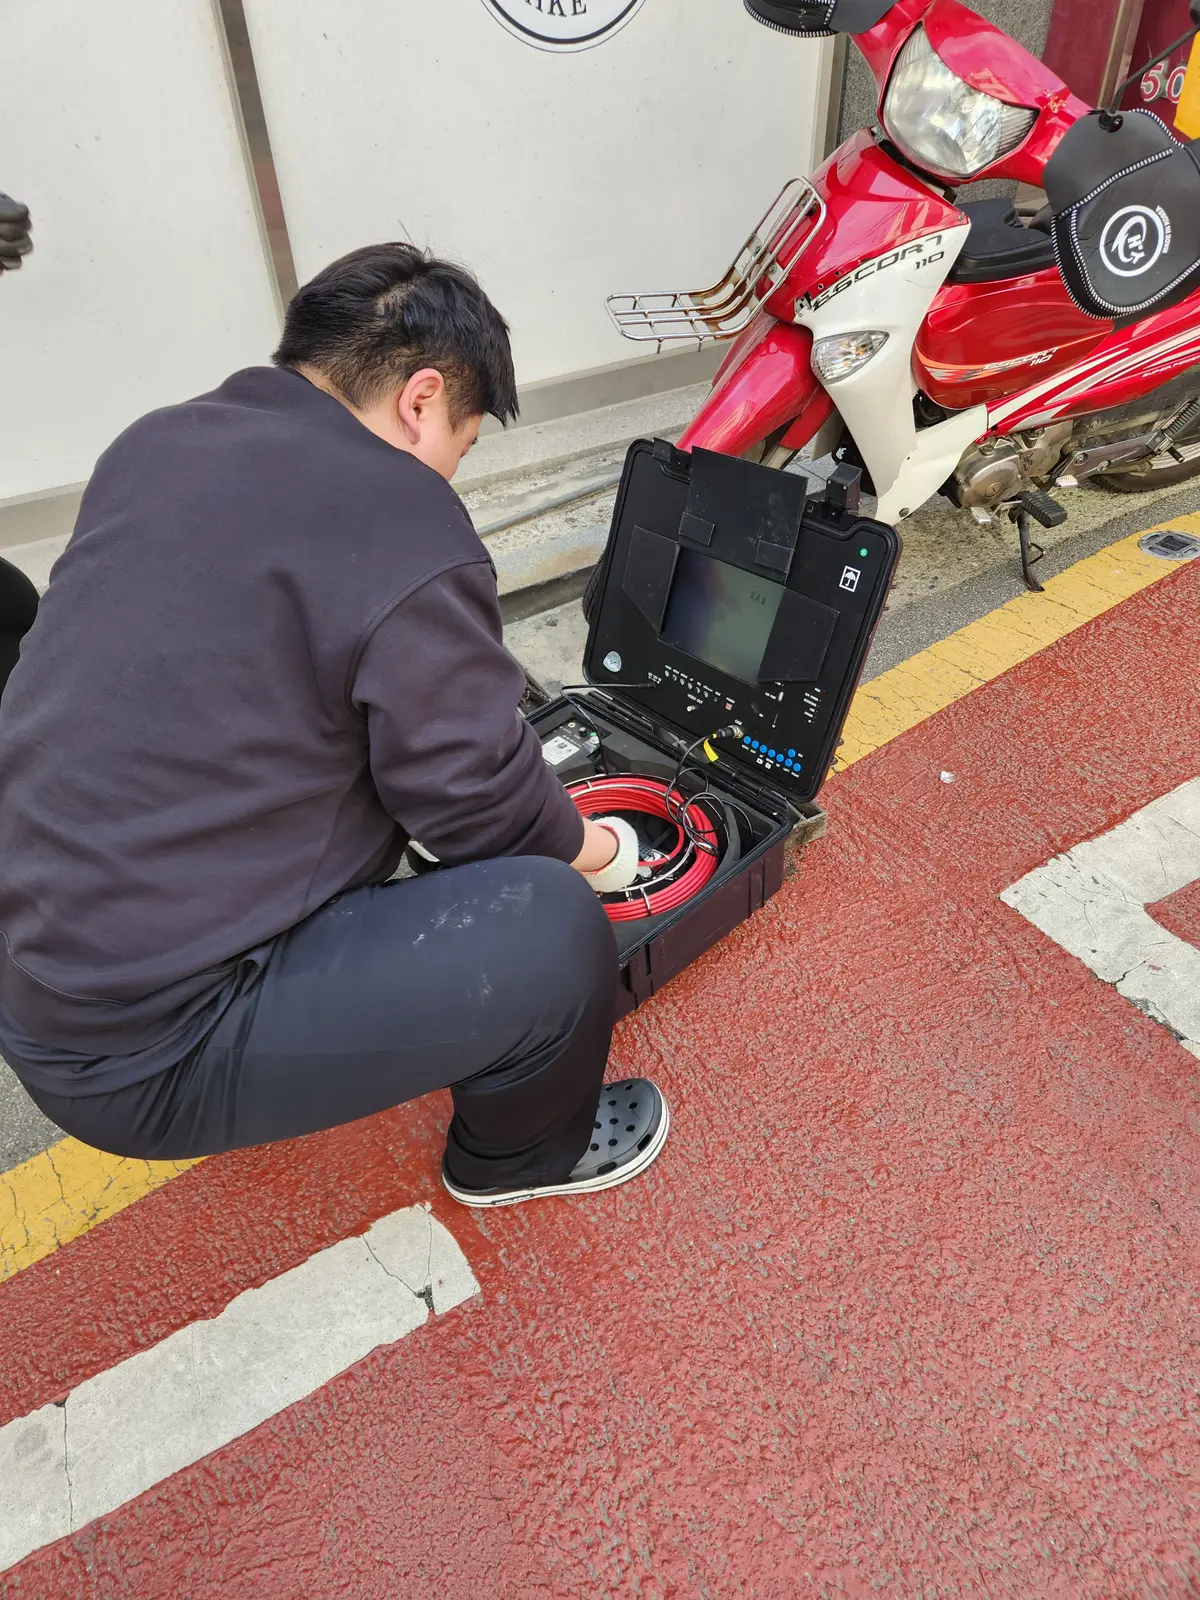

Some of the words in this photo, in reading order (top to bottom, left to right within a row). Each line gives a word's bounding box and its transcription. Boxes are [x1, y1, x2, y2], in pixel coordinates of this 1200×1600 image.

[1155, 205, 1171, 226] KOREA
[1162, 234, 1172, 254] MADE
[915, 251, 945, 270] 110
[1029, 354, 1053, 367] 110
